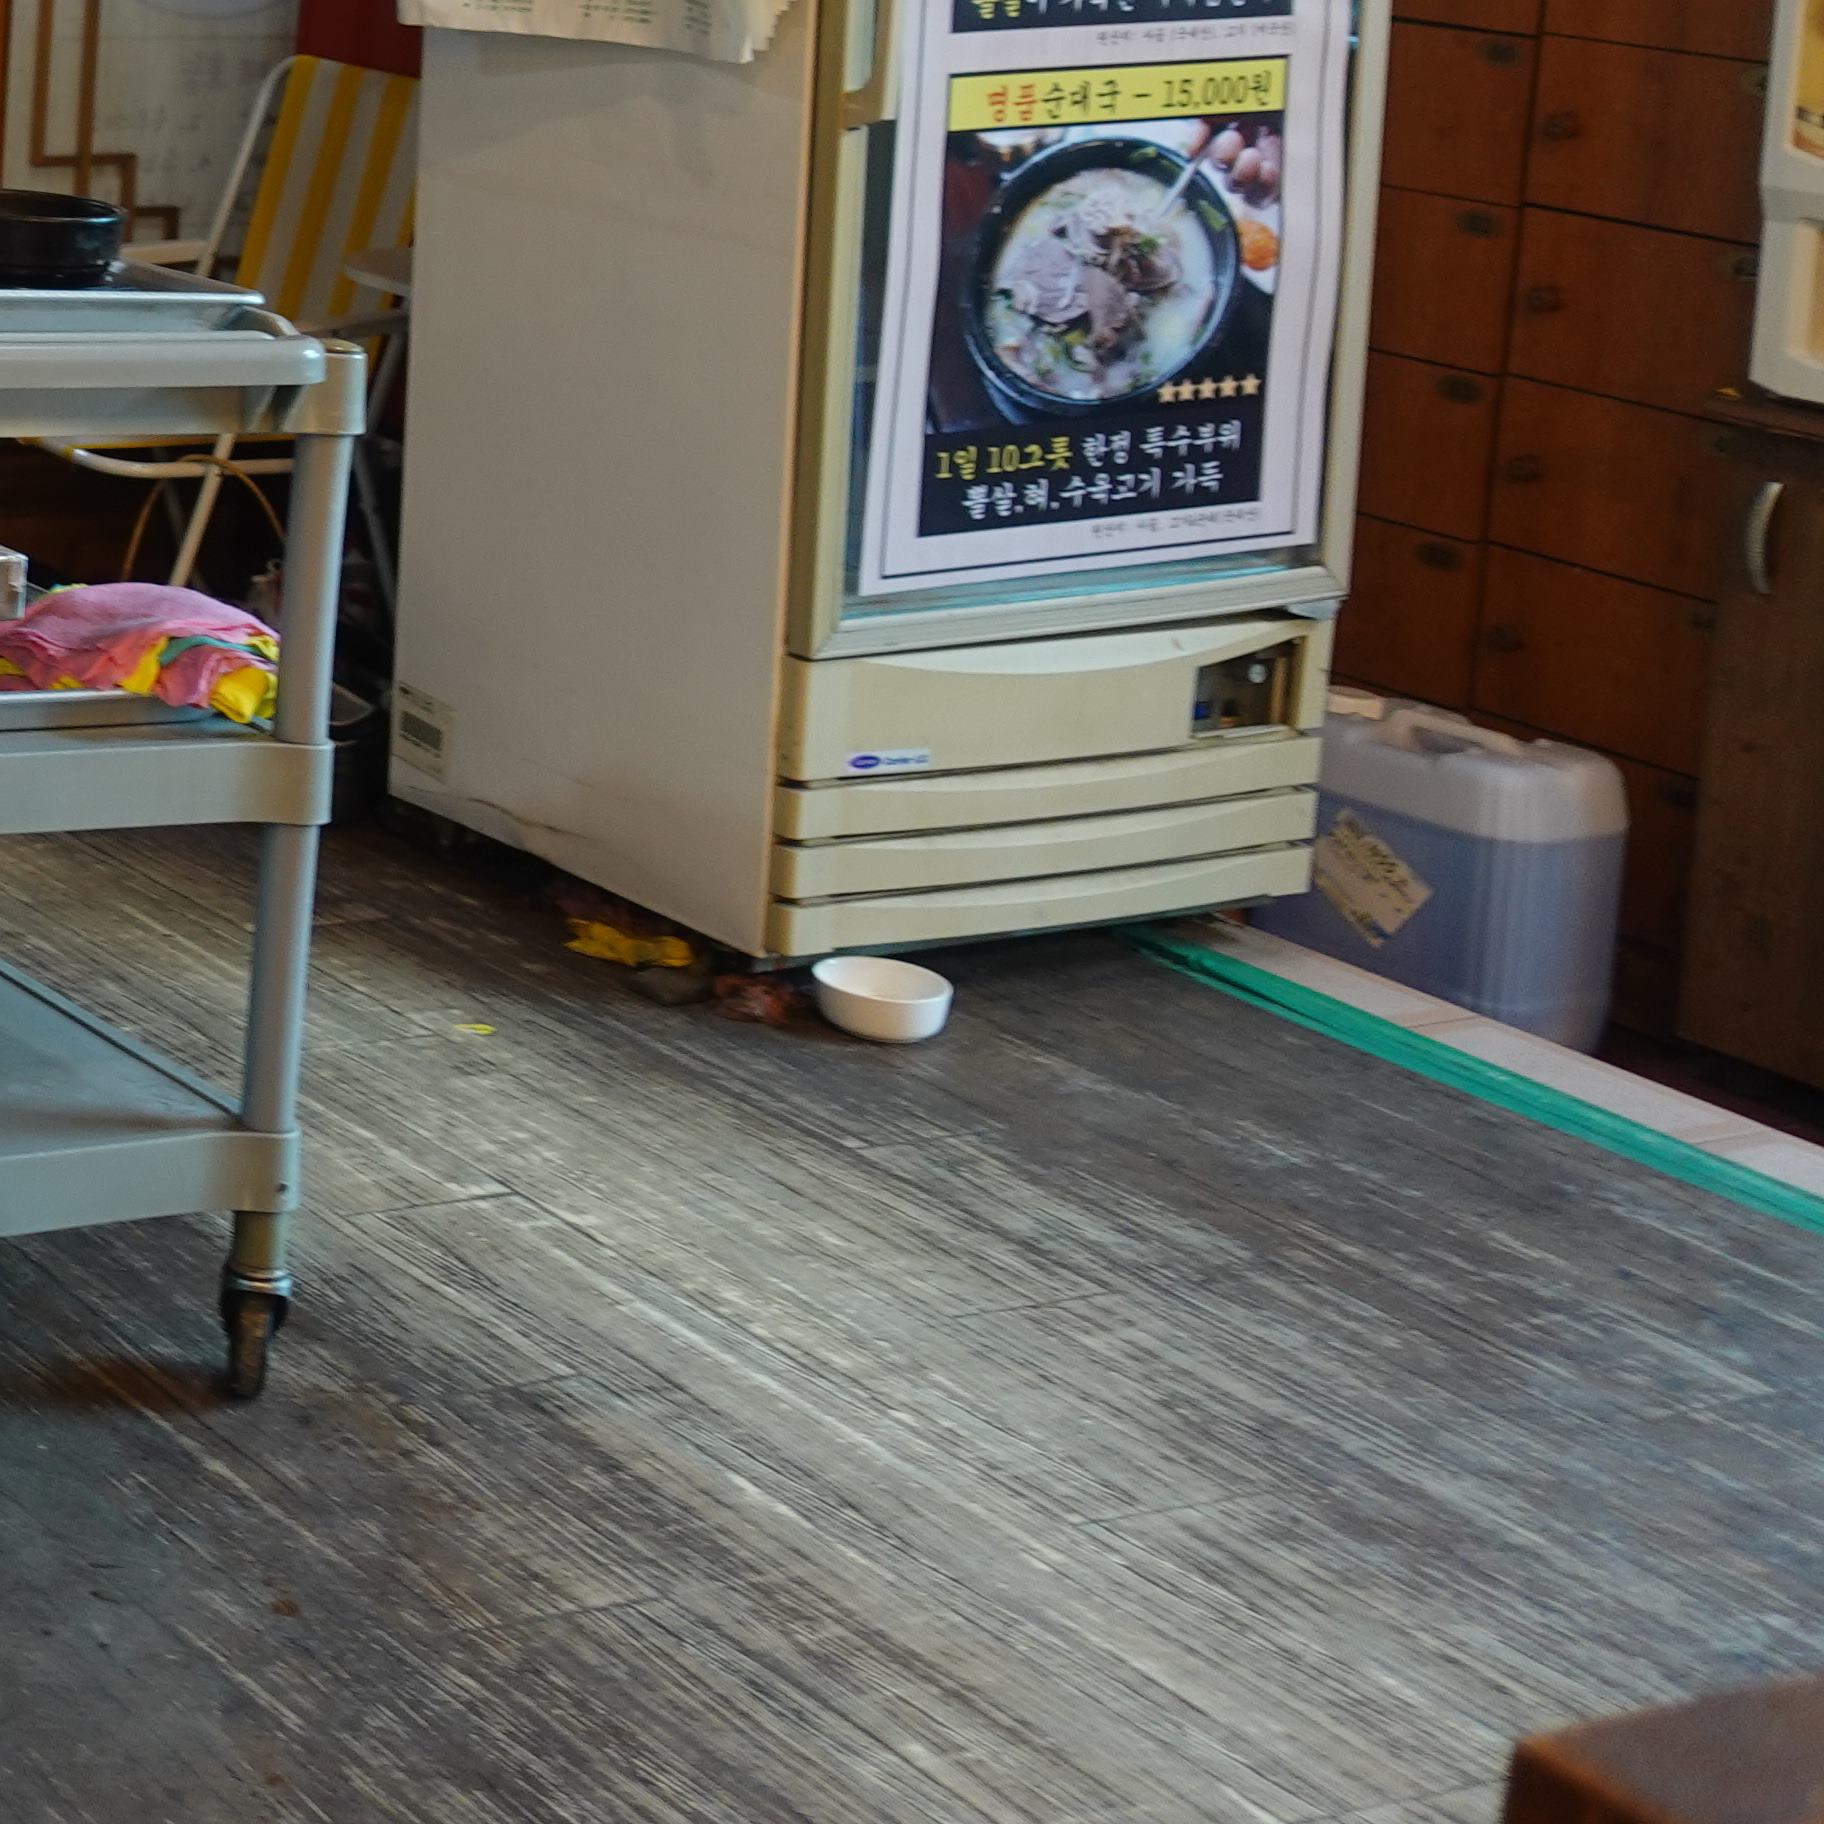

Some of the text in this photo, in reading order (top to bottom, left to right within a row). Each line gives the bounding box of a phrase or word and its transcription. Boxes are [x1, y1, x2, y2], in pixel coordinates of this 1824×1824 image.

[986, 79, 1123, 124] 명품순대국
[934, 418, 1242, 481] 1일 10그릇 한정 특수부위
[1171, 460, 1224, 496] 가득
